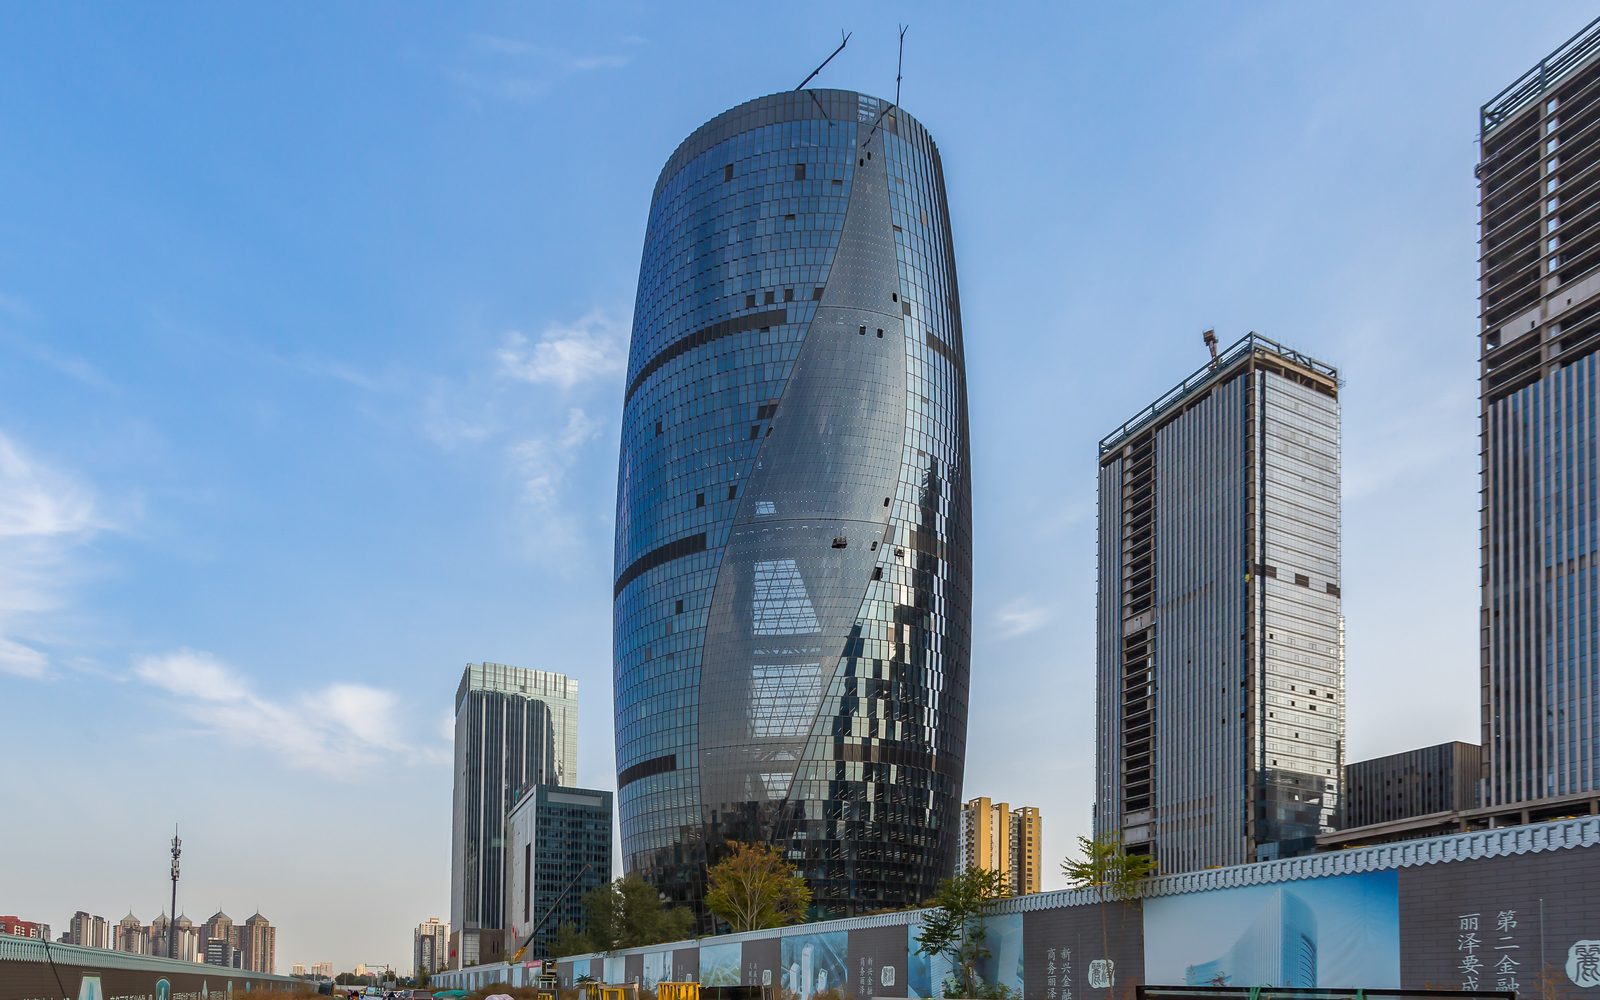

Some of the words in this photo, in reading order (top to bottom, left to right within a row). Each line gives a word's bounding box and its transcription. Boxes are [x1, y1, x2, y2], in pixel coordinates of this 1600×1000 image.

[1047, 947, 1057, 1000] 商务丽泽
[1060, 947, 1072, 1000] 新兴金融
[1494, 909, 1520, 996] 第二金融
